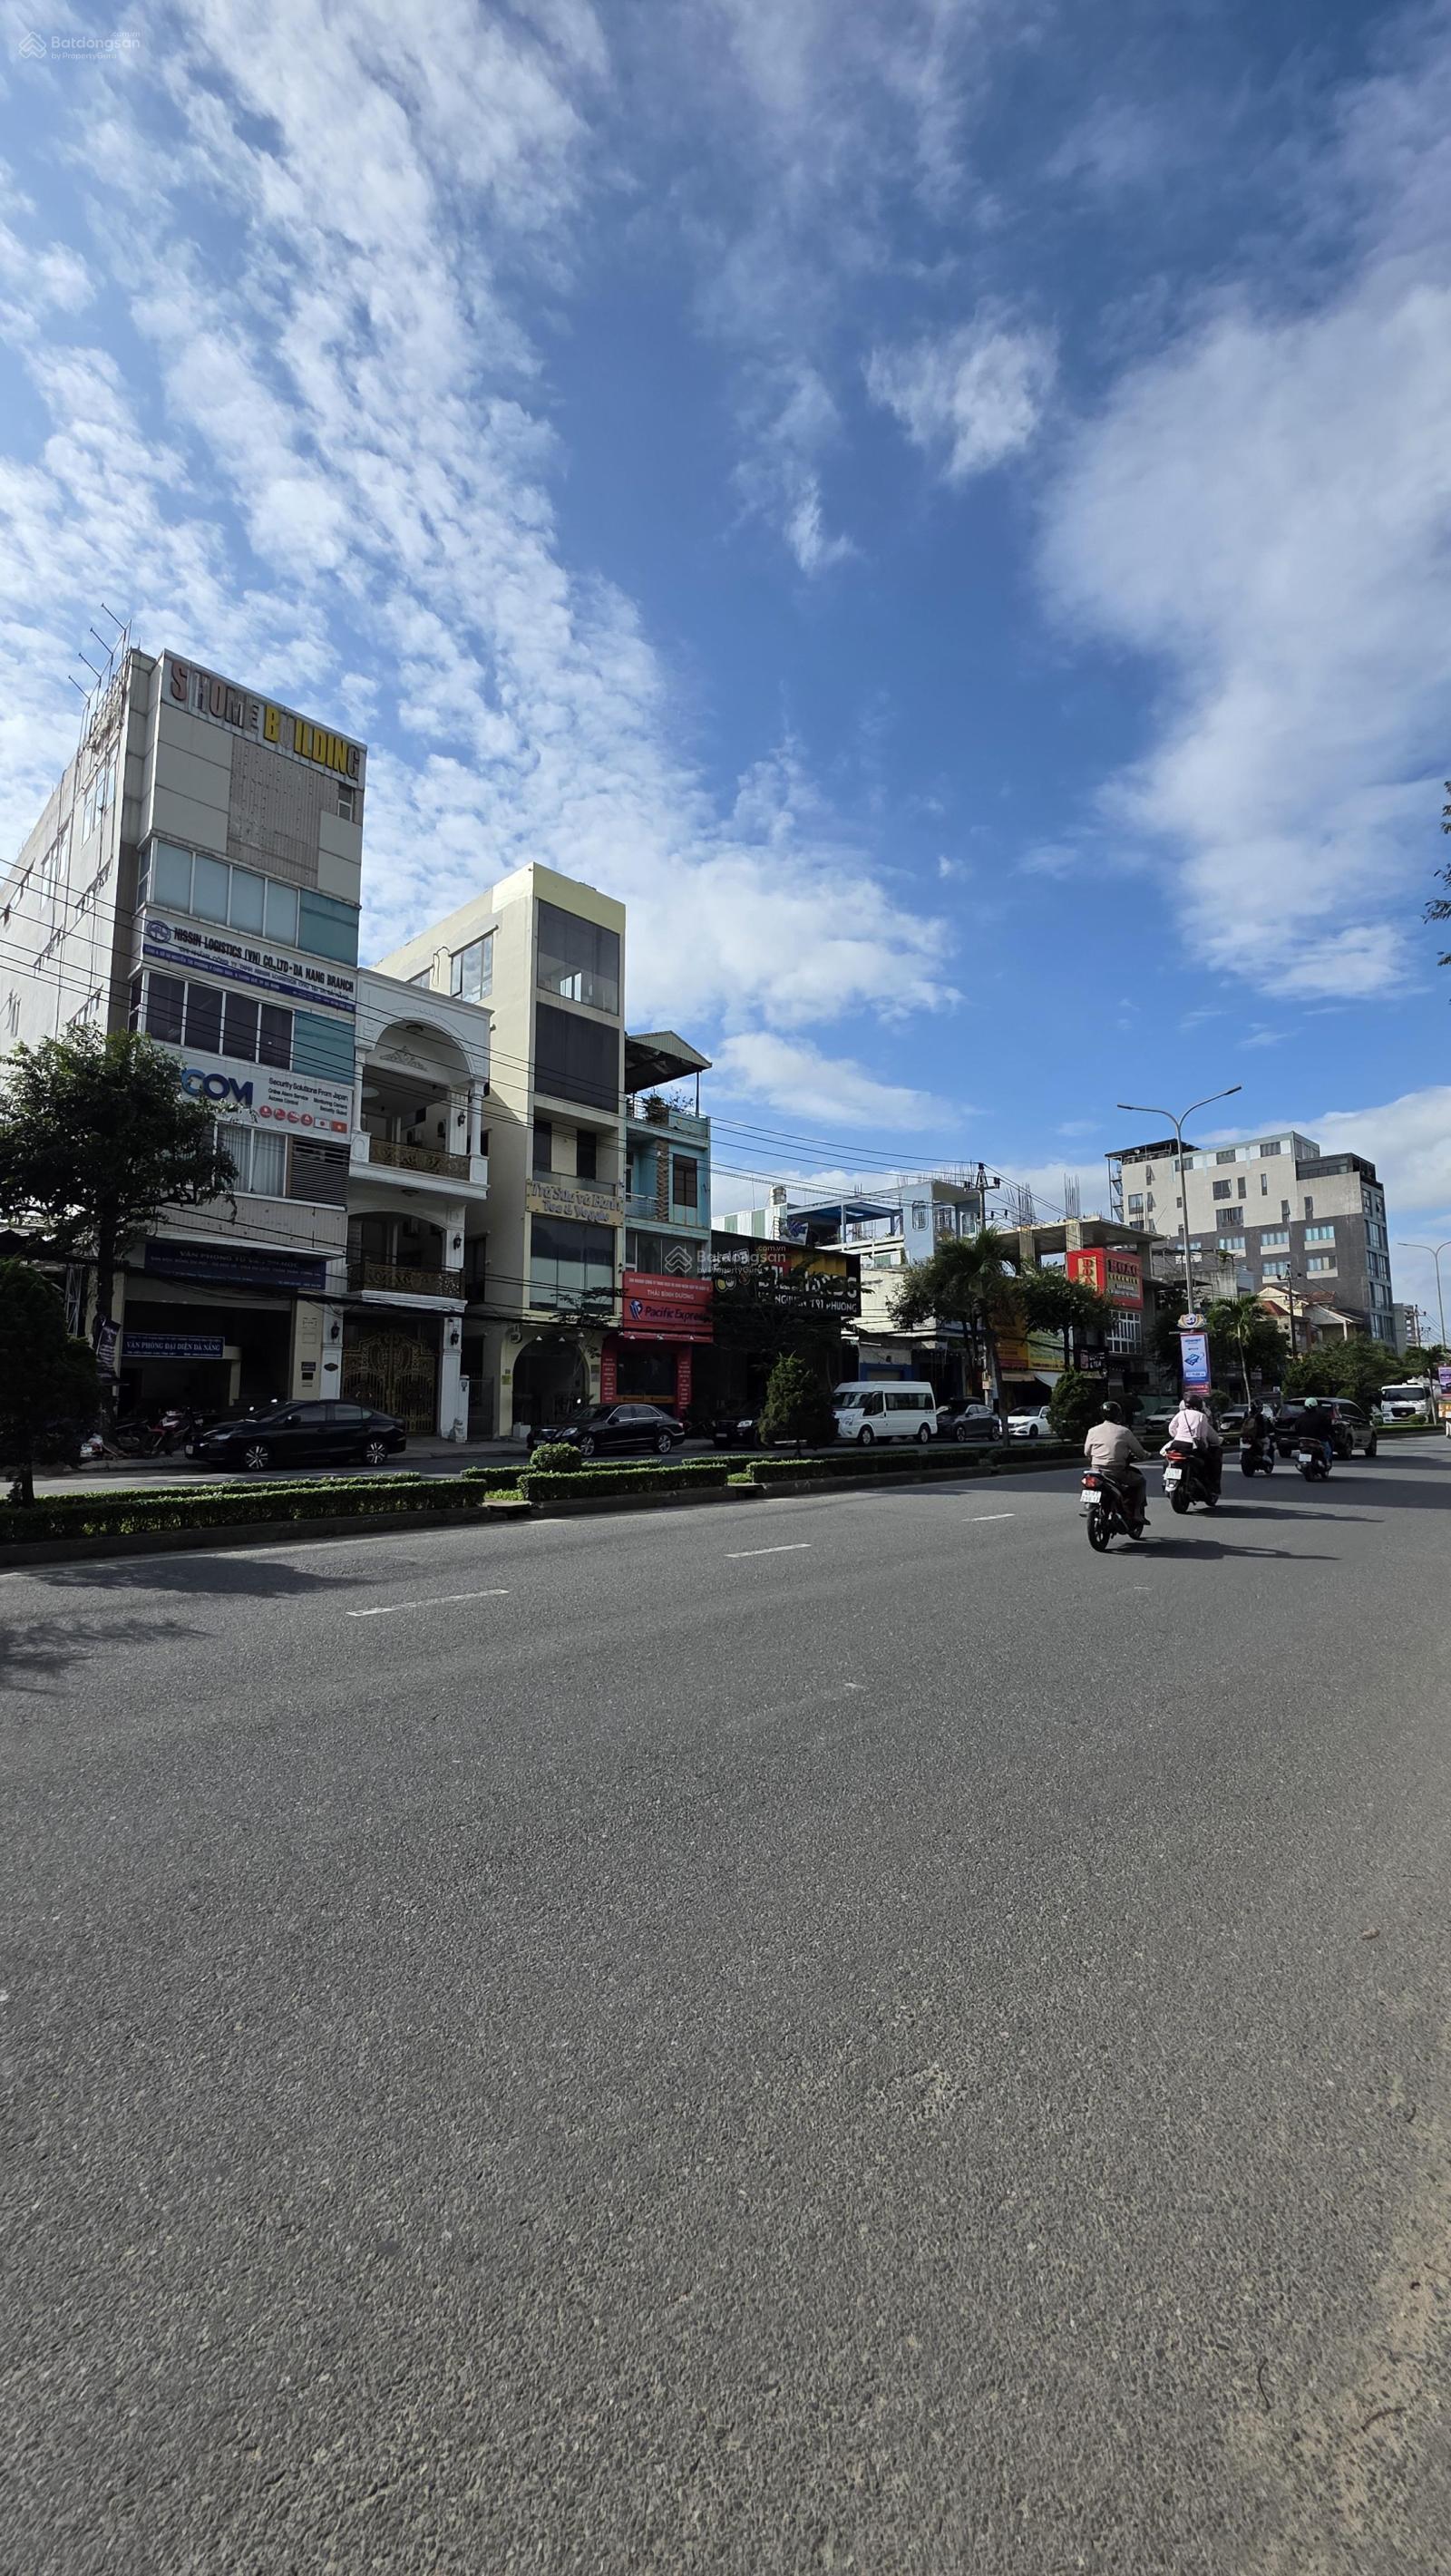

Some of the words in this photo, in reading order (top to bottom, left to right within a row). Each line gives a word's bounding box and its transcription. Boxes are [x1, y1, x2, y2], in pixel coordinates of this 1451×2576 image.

[263, 704, 360, 782] BUILDING
[174, 927, 202, 947] NISSIN
[204, 936, 242, 958] LOGISTICS
[306, 967, 325, 984] NANG
[327, 973, 354, 993] BRANCH
[180, 1068, 254, 1106] COM
[268, 1077, 293, 1090] Security
[293, 1083, 317, 1094] Solutions
[317, 1088, 333, 1098] From
[333, 1092, 348, 1102] Japan
[294, 1093, 309, 1101] Service
[319, 1105, 336, 1114] Security
[645, 1306, 673, 1318] Pacific
[675, 1308, 706, 1322] Expre
